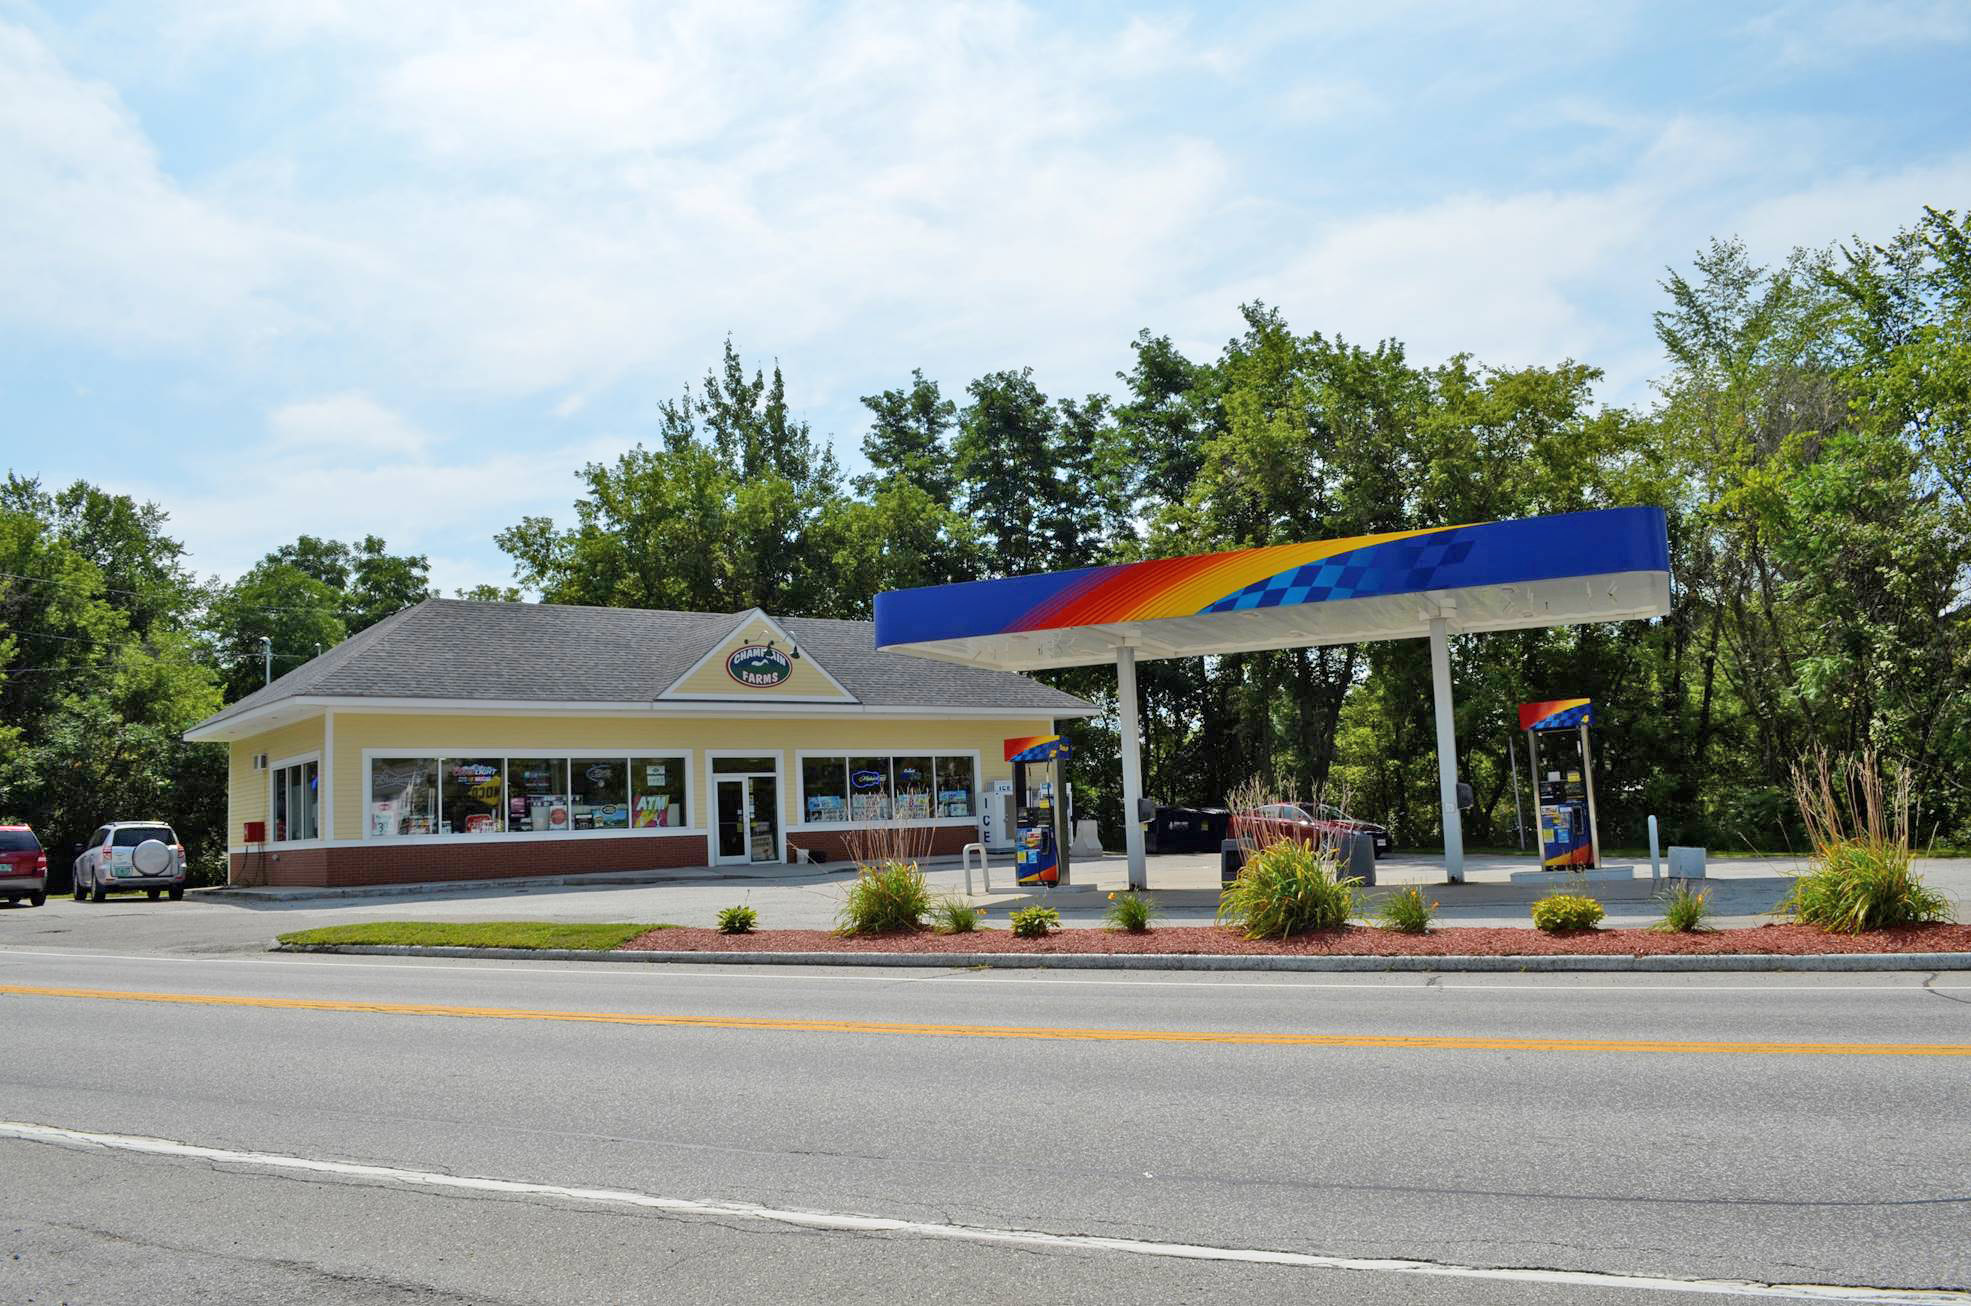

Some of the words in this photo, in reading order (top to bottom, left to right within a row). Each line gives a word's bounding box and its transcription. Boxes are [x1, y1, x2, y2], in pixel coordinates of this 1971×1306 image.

[742, 671, 779, 684] FARMS
[636, 795, 670, 811] ATM
[982, 798, 991, 843] ICE
